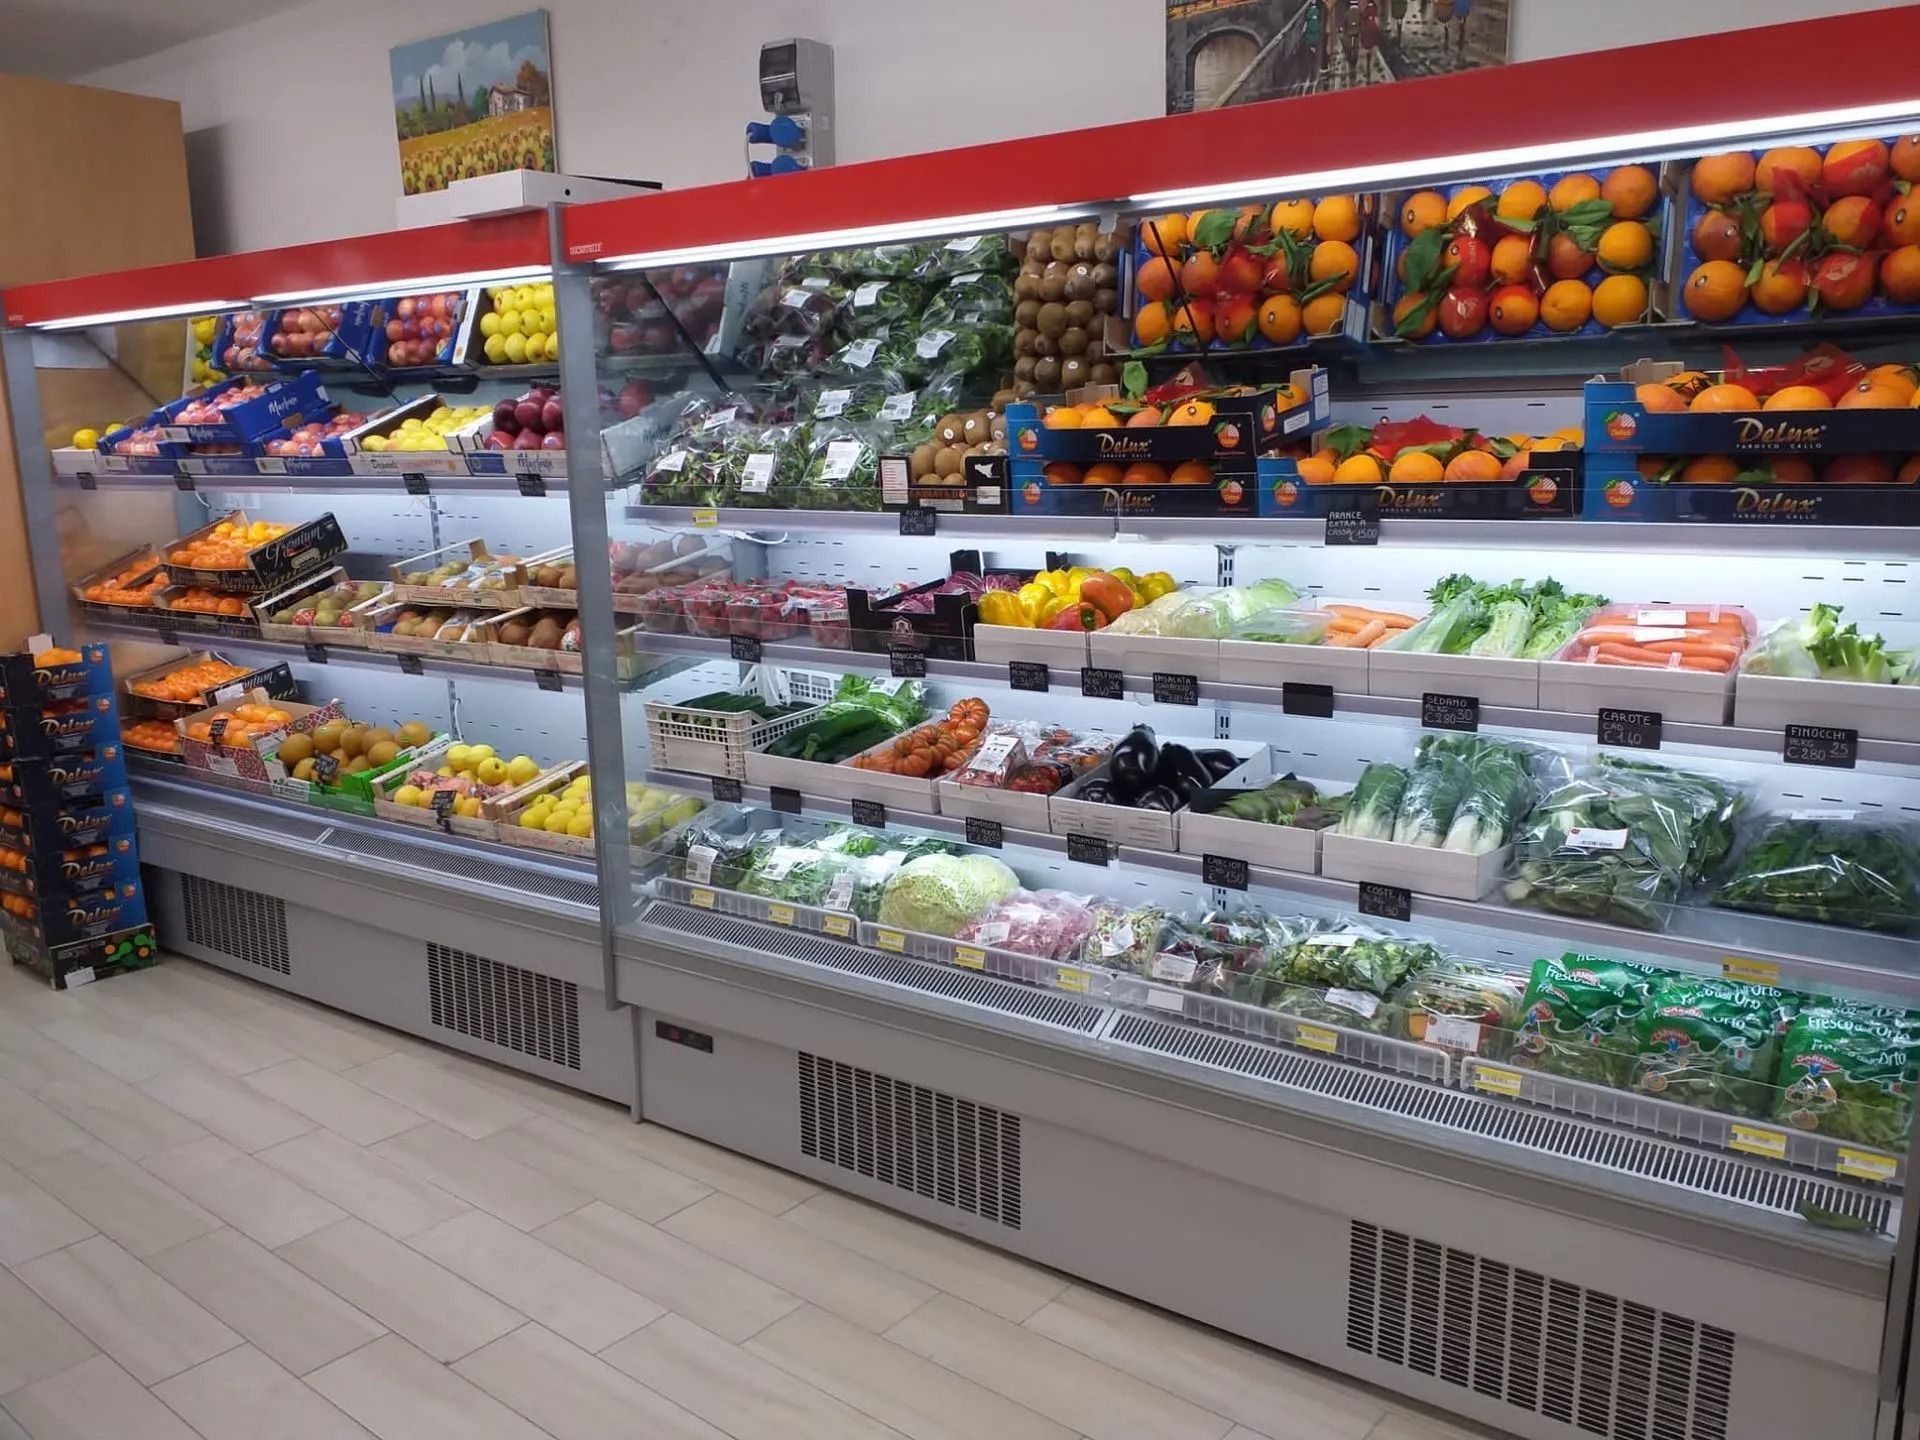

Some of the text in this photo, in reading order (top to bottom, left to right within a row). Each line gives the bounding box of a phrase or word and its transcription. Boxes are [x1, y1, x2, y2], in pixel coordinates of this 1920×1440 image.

[1732, 417, 1820, 442] Delux
[1095, 433, 1149, 454] Delux
[1098, 487, 1153, 511] Delux
[1374, 486, 1440, 508] Delux
[1729, 487, 1816, 513] Delux
[1329, 511, 1363, 520] ARANCE
[32, 669, 88, 686] Delux
[40, 718, 95, 737] Delux
[1602, 712, 1651, 726] CAROTE
[1830, 742, 1849, 756] 25
[48, 766, 103, 785] Delux
[57, 814, 112, 834] Delux
[61, 860, 116, 879] Delux
[67, 906, 121, 925] Delux
[1808, 1016, 1853, 1030] Fresco
